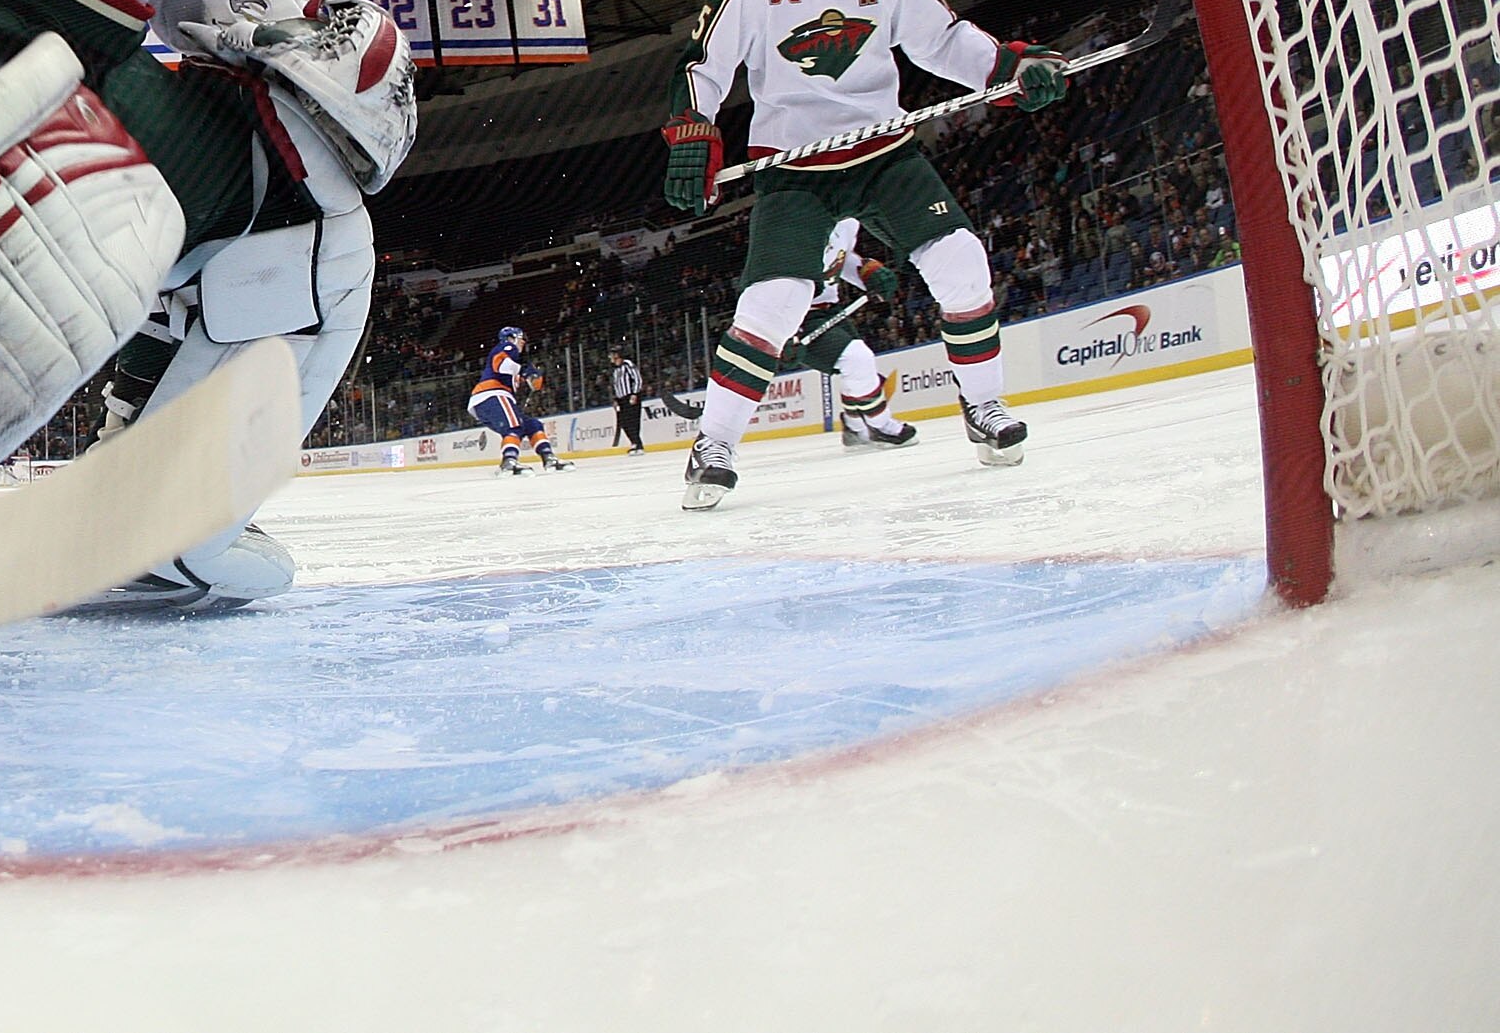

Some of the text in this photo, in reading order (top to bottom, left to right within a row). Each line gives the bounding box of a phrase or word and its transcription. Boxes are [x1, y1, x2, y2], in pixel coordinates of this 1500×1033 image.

[1057, 333, 1122, 366] Capital
[1160, 325, 1203, 349] Bank
[575, 425, 614, 442] Optimum
